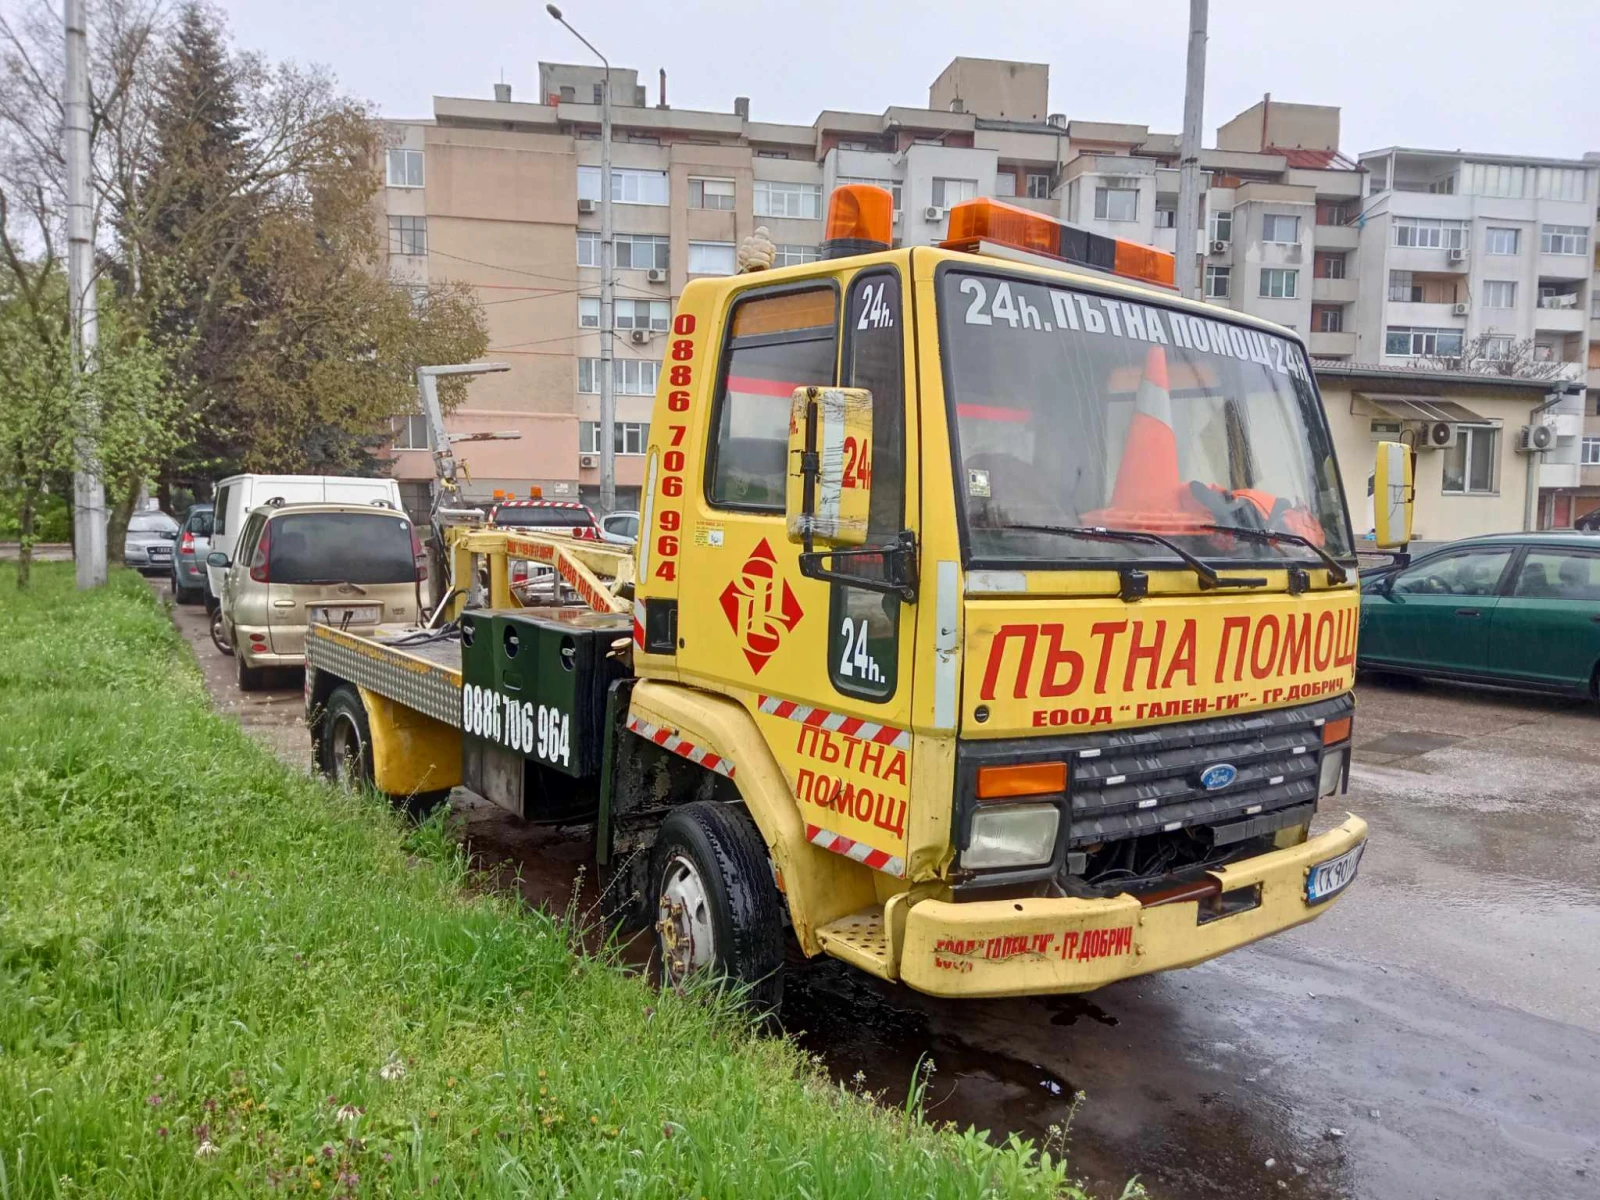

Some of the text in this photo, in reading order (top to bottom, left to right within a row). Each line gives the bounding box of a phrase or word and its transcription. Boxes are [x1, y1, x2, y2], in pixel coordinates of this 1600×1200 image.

[857, 282, 894, 330] 24h.
[1048, 290, 1168, 345] ПЪТНА
[1168, 311, 1274, 370] ПОМОЩ
[655, 313, 696, 582] 0886 706 964
[839, 617, 886, 684] 24h.
[979, 606, 1358, 701] ПЪТНА ПОМОЩ
[502, 694, 534, 754] 706
[537, 704, 571, 767] 964
[1032, 705, 1113, 728] ЕООД
[796, 723, 907, 786] ПЪТНА
[795, 768, 908, 840] ПОМОЩ
